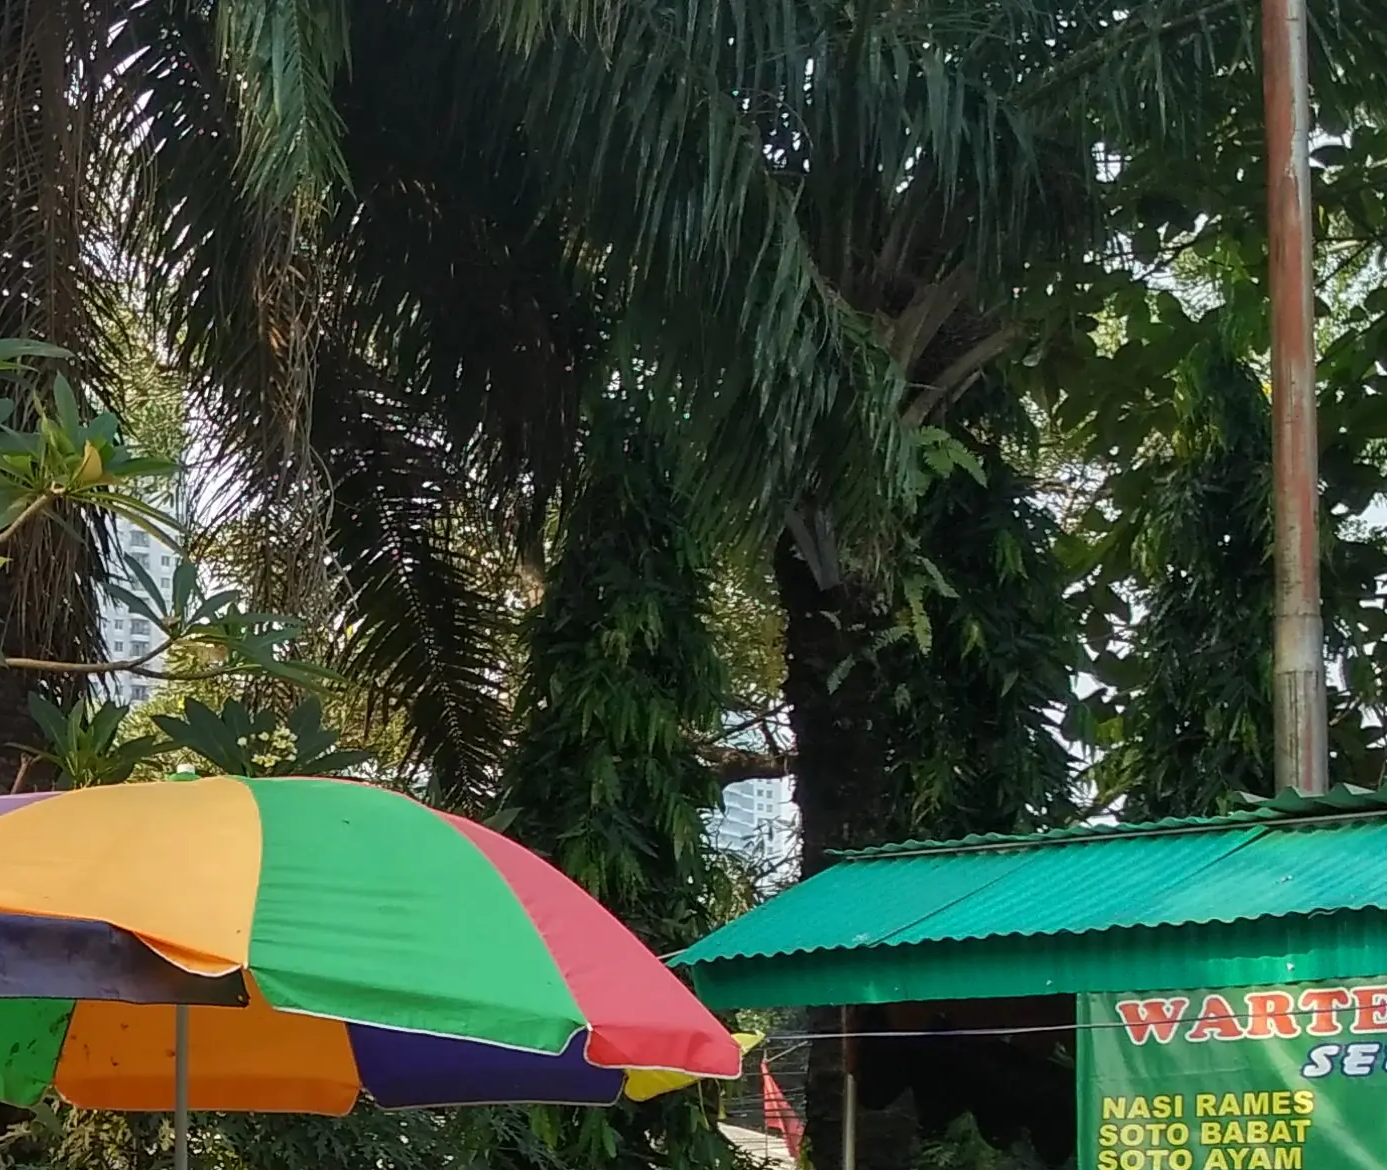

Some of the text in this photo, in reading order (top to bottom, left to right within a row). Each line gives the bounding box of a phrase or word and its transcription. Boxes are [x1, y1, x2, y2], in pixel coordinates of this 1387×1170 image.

[1116, 985, 1387, 1045] WARTE
[1301, 1042, 1387, 1078] SE
[1102, 1090, 1314, 1120] NASI RAMES
[1099, 1119, 1312, 1146] SOTO BABAT
[1203, 1147, 1302, 1170] AYAM
